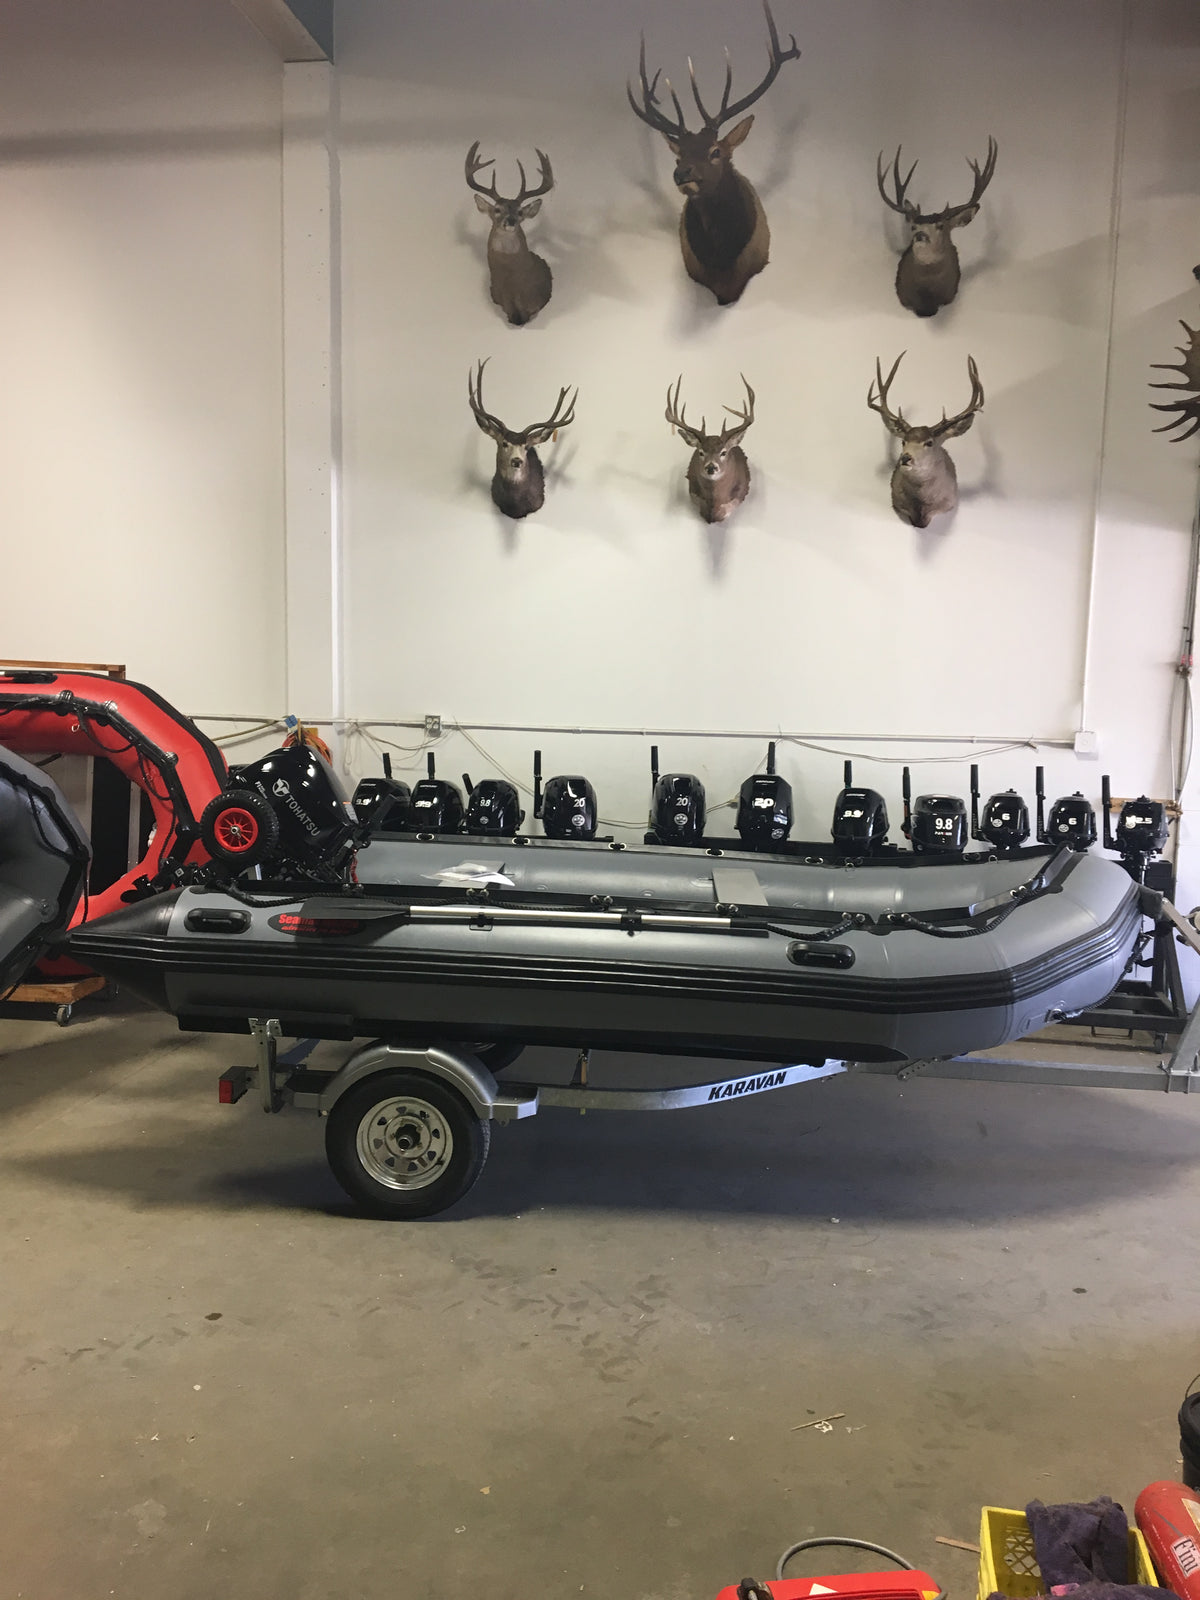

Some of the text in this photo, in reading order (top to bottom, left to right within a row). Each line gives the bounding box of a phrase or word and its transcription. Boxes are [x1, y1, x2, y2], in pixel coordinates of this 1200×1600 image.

[573, 797, 586, 808] 20
[675, 797, 689, 806] 20
[285, 794, 320, 837] TOHATSU
[1001, 812, 1011, 821] 6
[1068, 817, 1078, 826] 6
[935, 817, 953, 830] 9.8
[708, 1071, 787, 1101] KARAVAN
[1174, 1539, 1198, 1574] Fini
